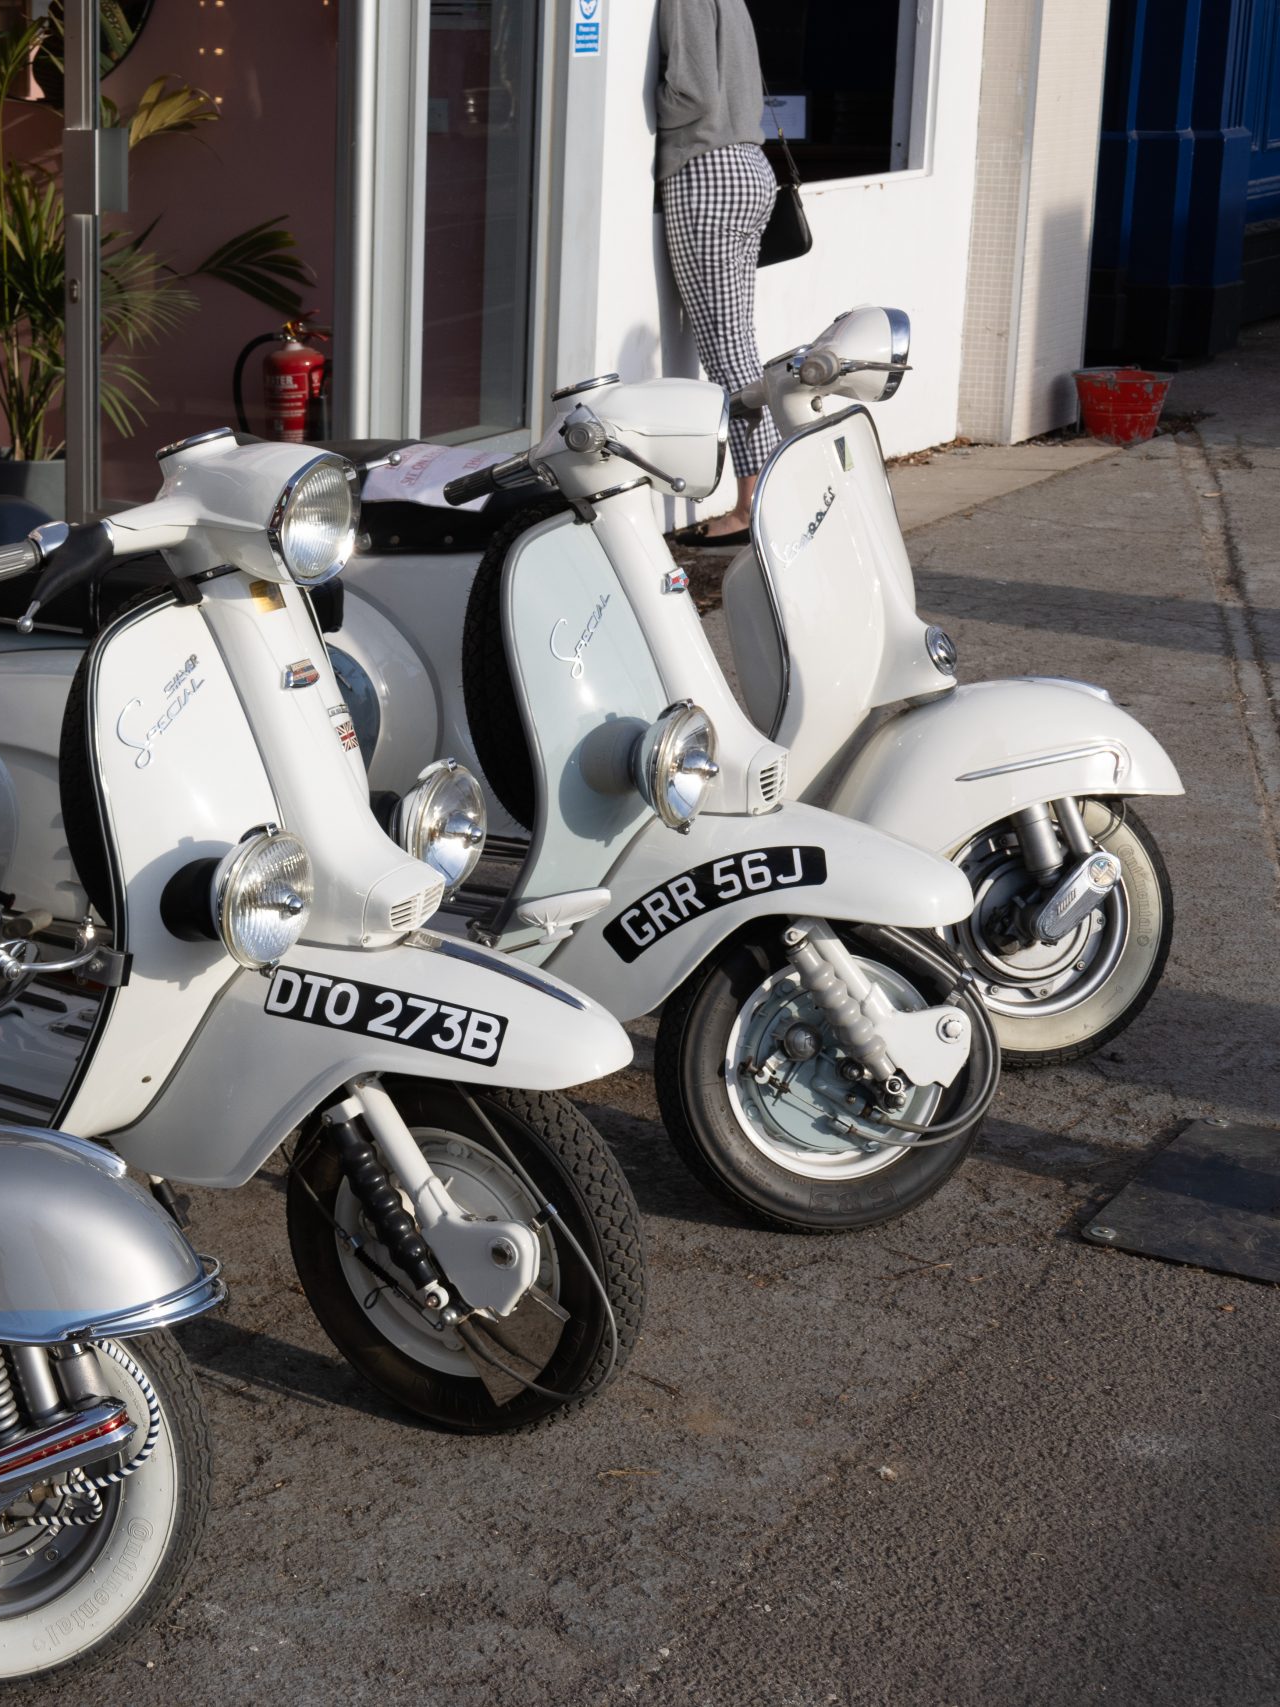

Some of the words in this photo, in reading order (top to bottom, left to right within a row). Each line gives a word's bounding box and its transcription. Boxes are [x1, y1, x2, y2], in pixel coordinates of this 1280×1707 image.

[620, 876, 706, 947] GRR
[712, 848, 803, 899] 56J
[266, 969, 360, 1026] DTO
[366, 991, 501, 1060] 273B
[45, 1517, 154, 1648] Continental
